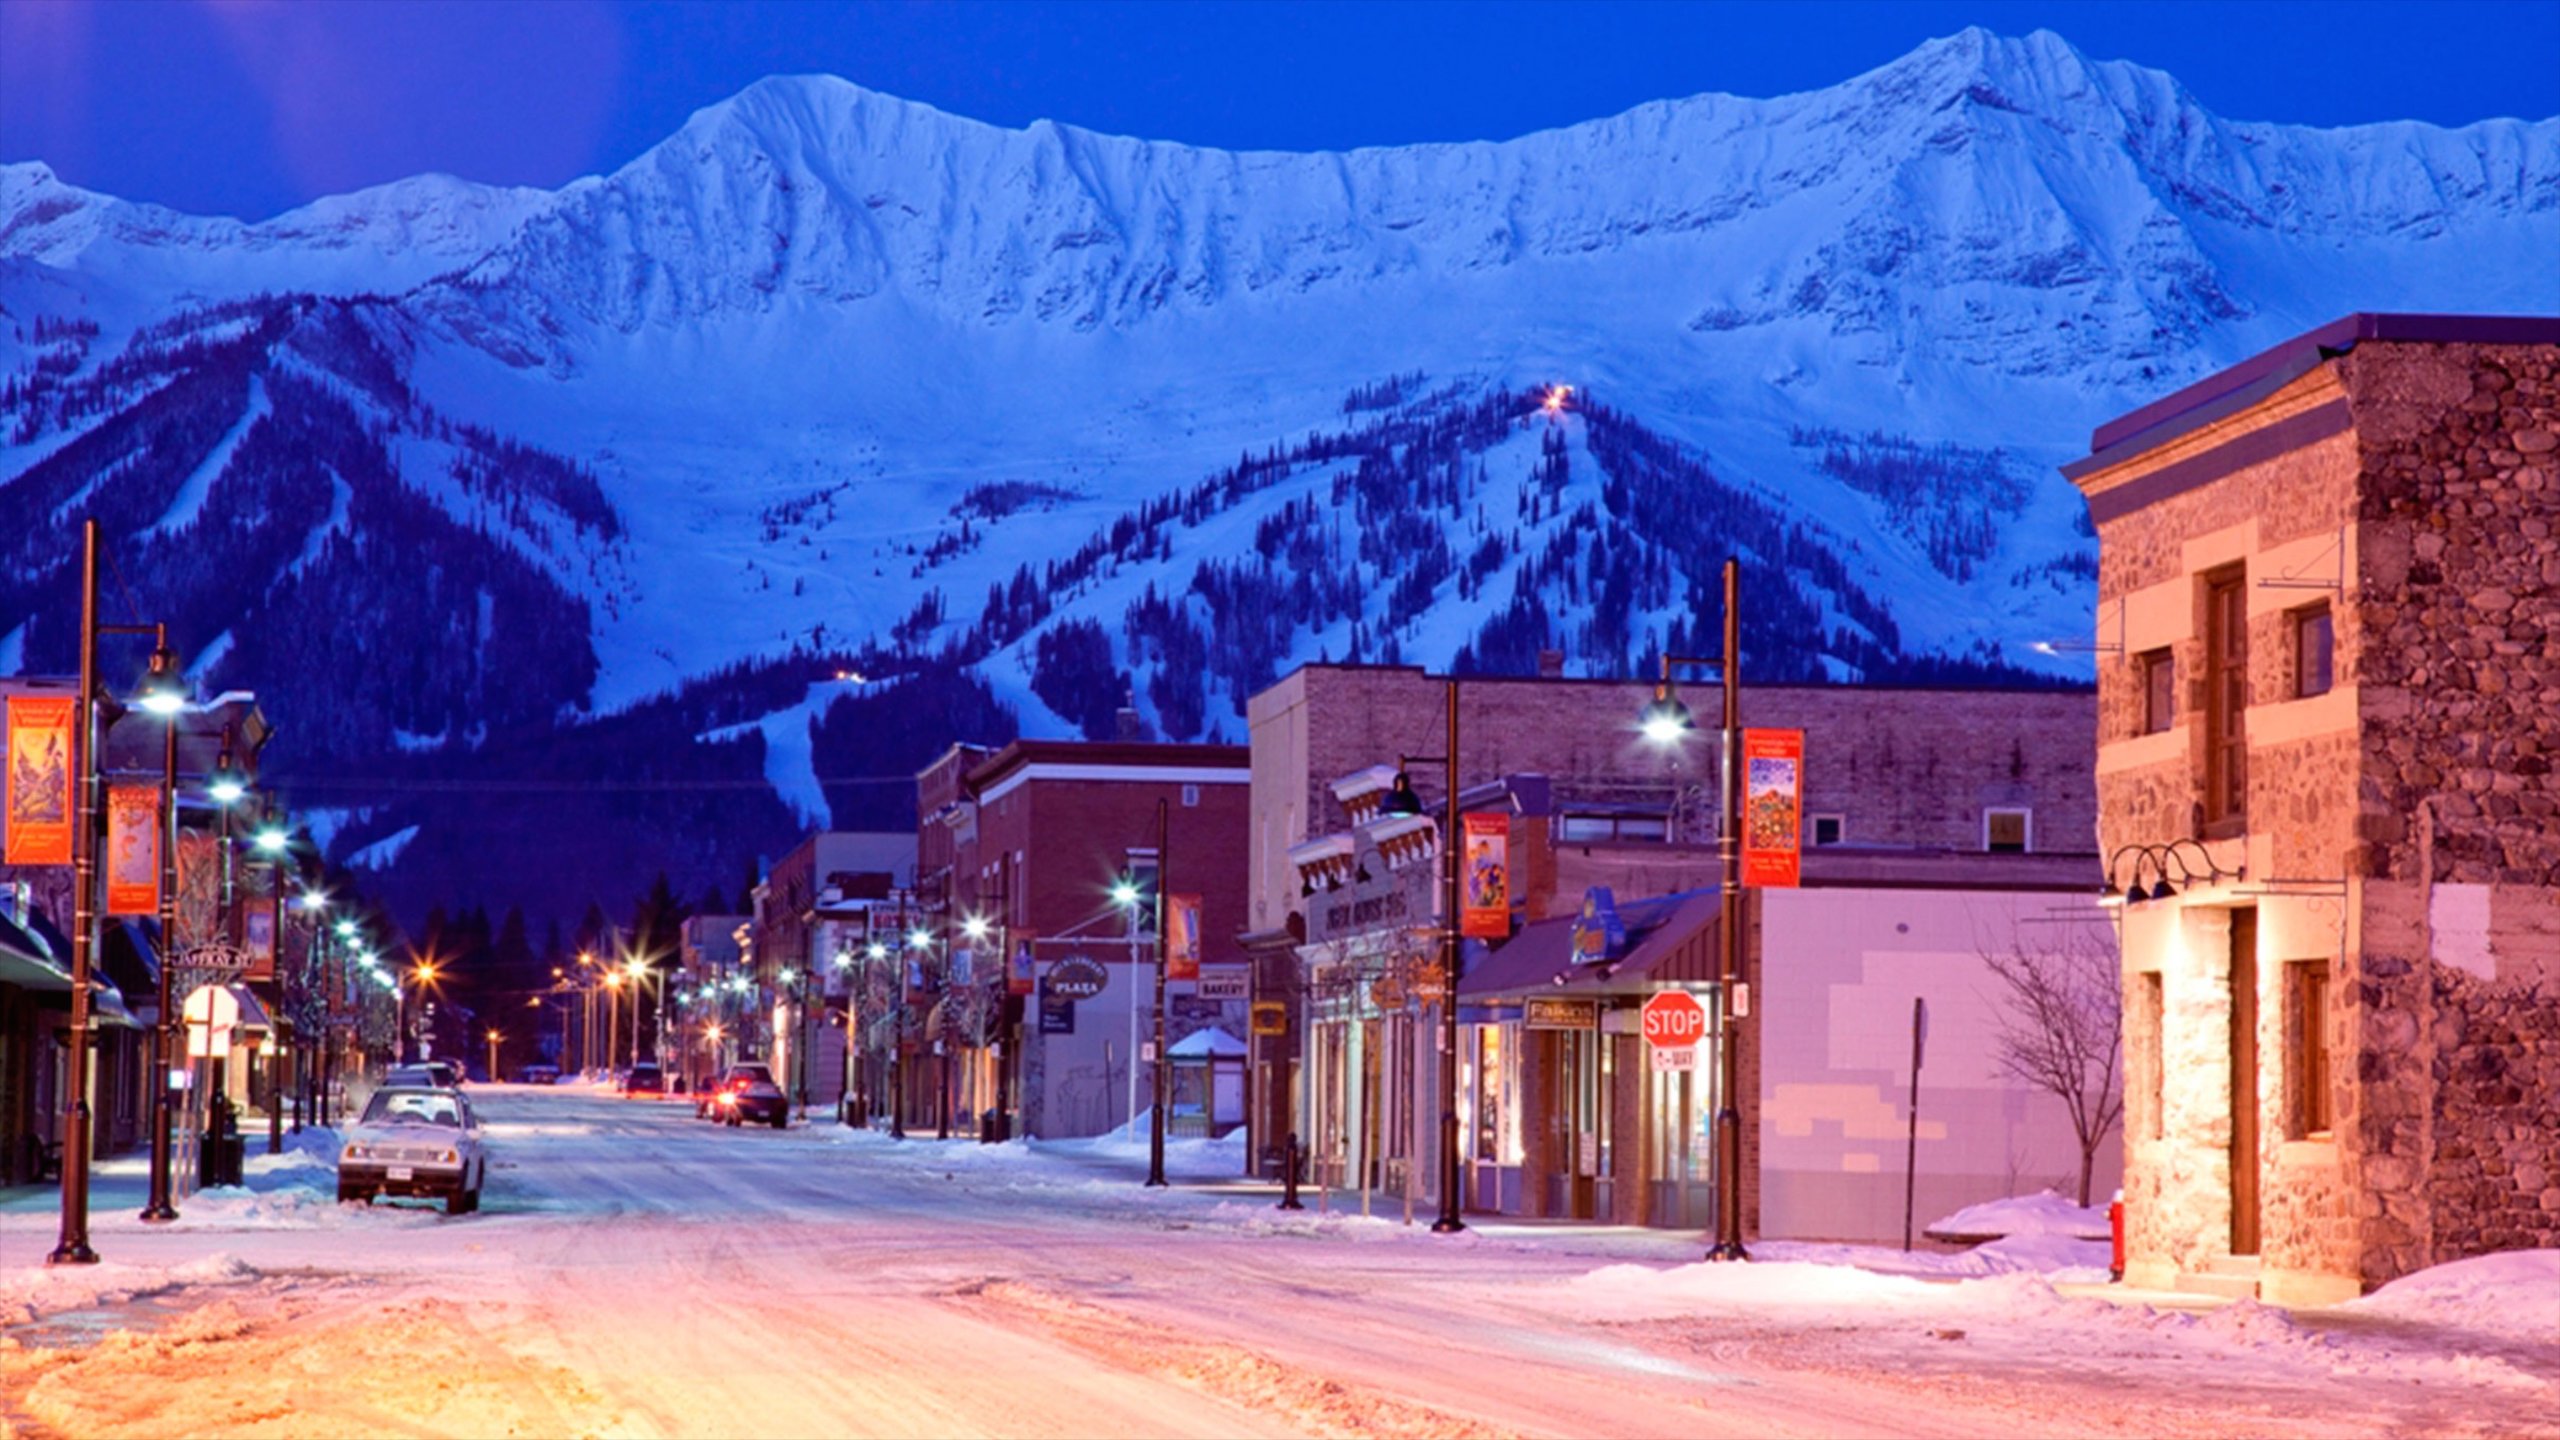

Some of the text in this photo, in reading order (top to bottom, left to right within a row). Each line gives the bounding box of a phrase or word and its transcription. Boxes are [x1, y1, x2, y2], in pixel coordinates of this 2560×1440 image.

[1056, 982, 1098, 995] PLAZA
[1203, 982, 1244, 996] BAKERY
[1646, 1009, 1701, 1036] STOP
